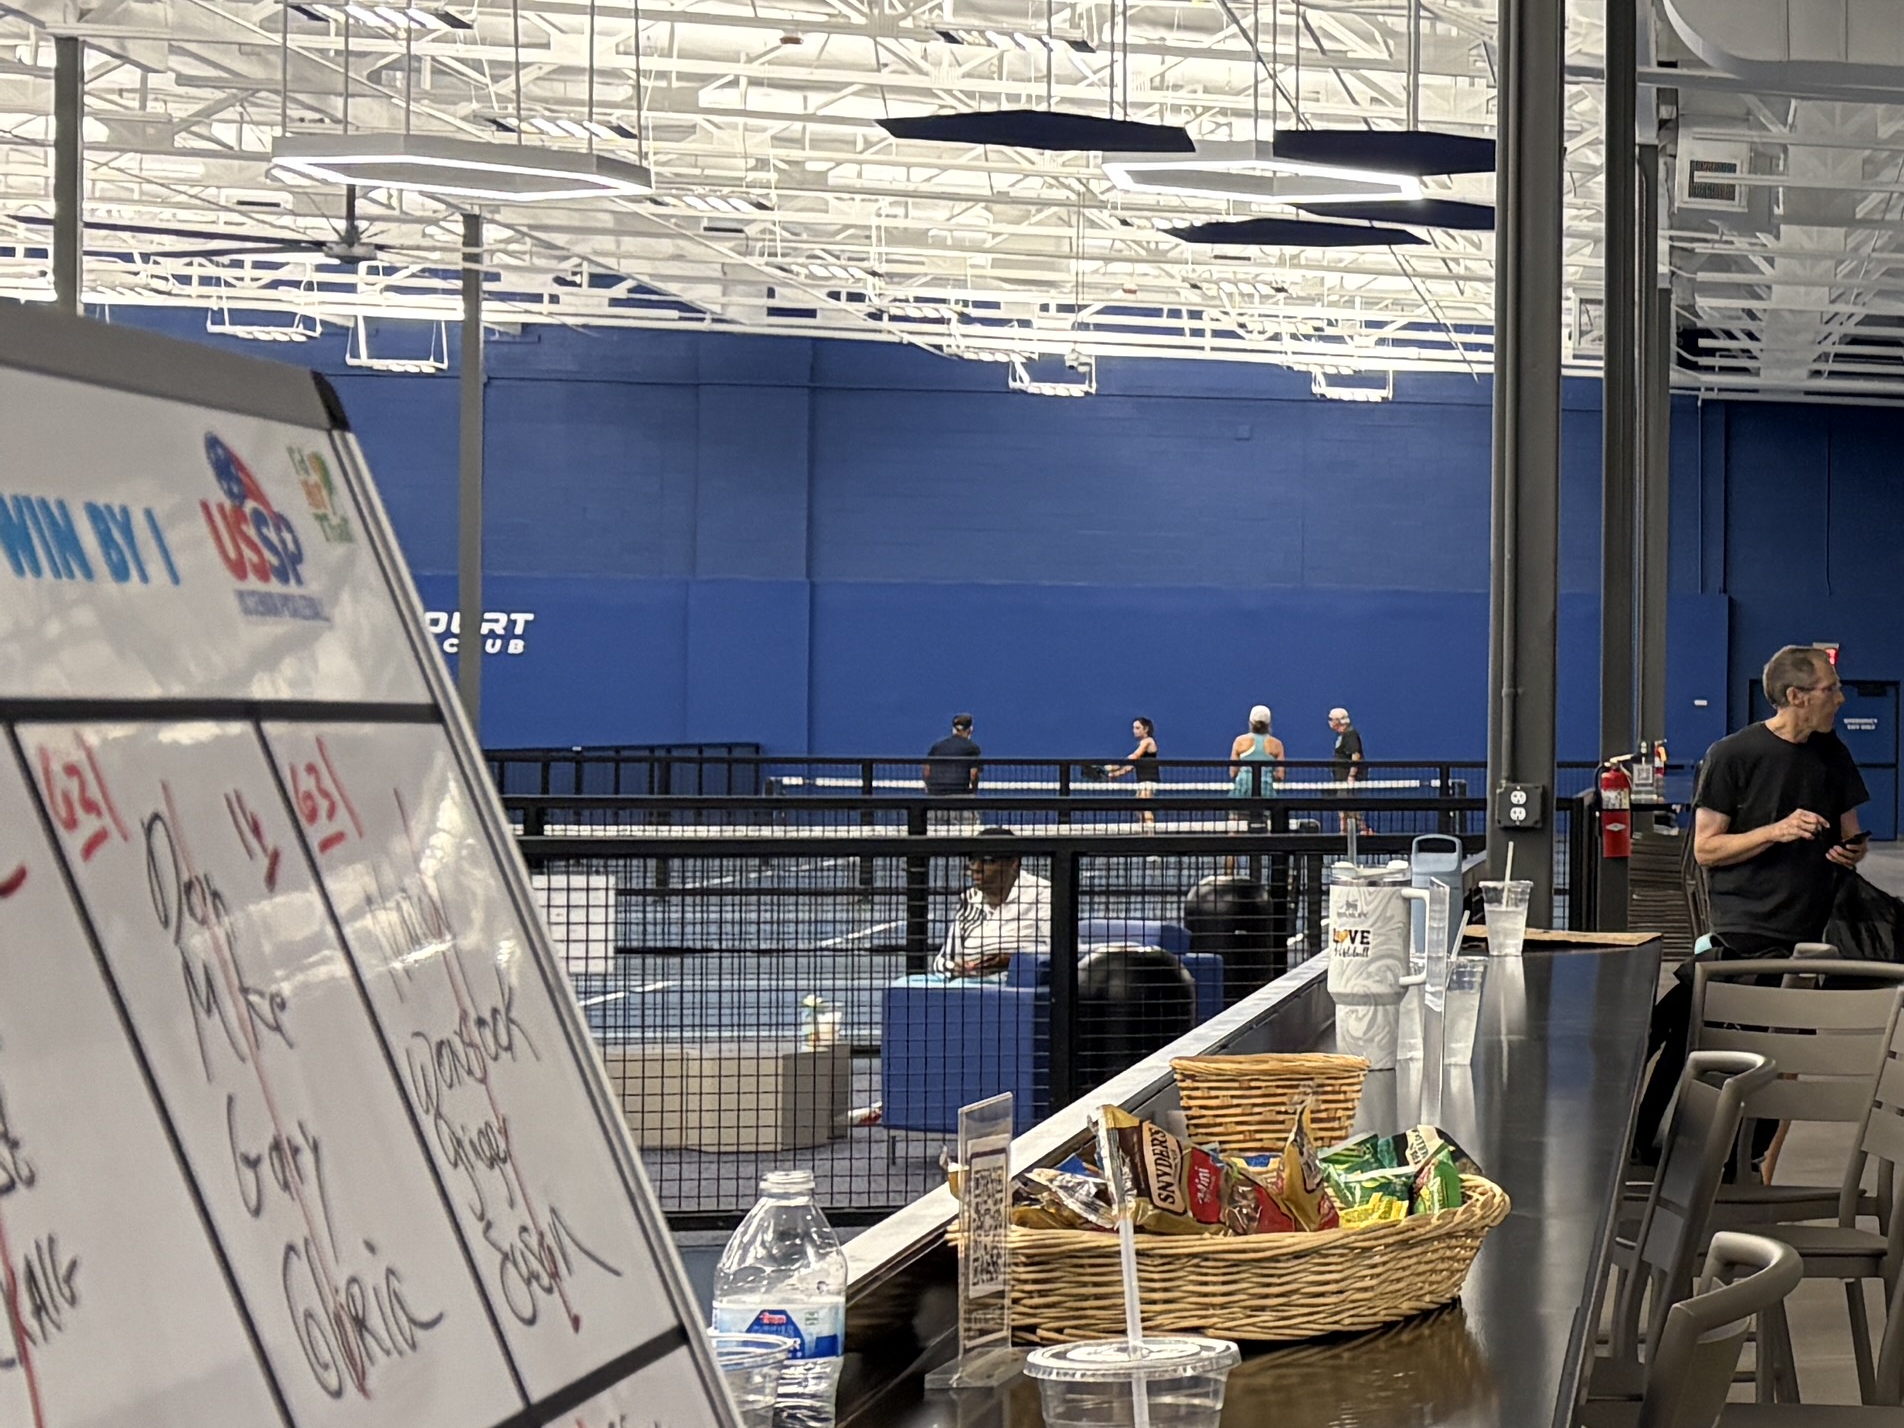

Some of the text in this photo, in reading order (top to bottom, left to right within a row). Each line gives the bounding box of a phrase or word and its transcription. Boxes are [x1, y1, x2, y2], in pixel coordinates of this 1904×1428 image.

[84, 501, 149, 585] BY
[442, 638, 525, 655] CUB
[289, 762, 336, 826] 63
